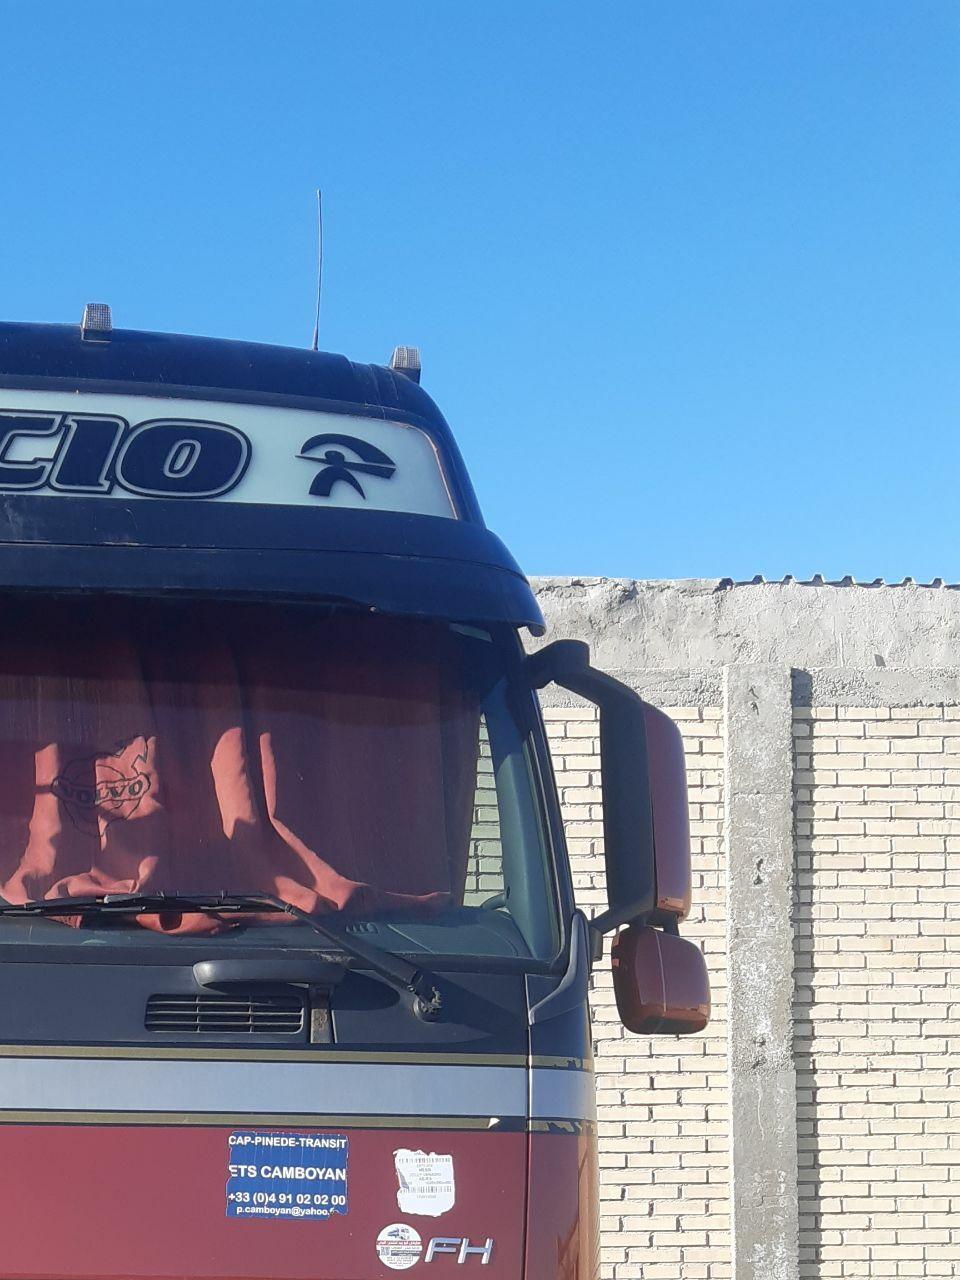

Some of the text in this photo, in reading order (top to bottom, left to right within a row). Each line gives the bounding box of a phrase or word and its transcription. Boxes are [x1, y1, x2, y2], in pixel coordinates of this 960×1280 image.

[228, 1135, 347, 1149] CAP-PINEDE-TRANSIT
[228, 1165, 346, 1181] ETS CAMBOYAN
[228, 1192, 346, 1206] +33 (0)4 91 02 02 00
[424, 1237, 493, 1264] FH
